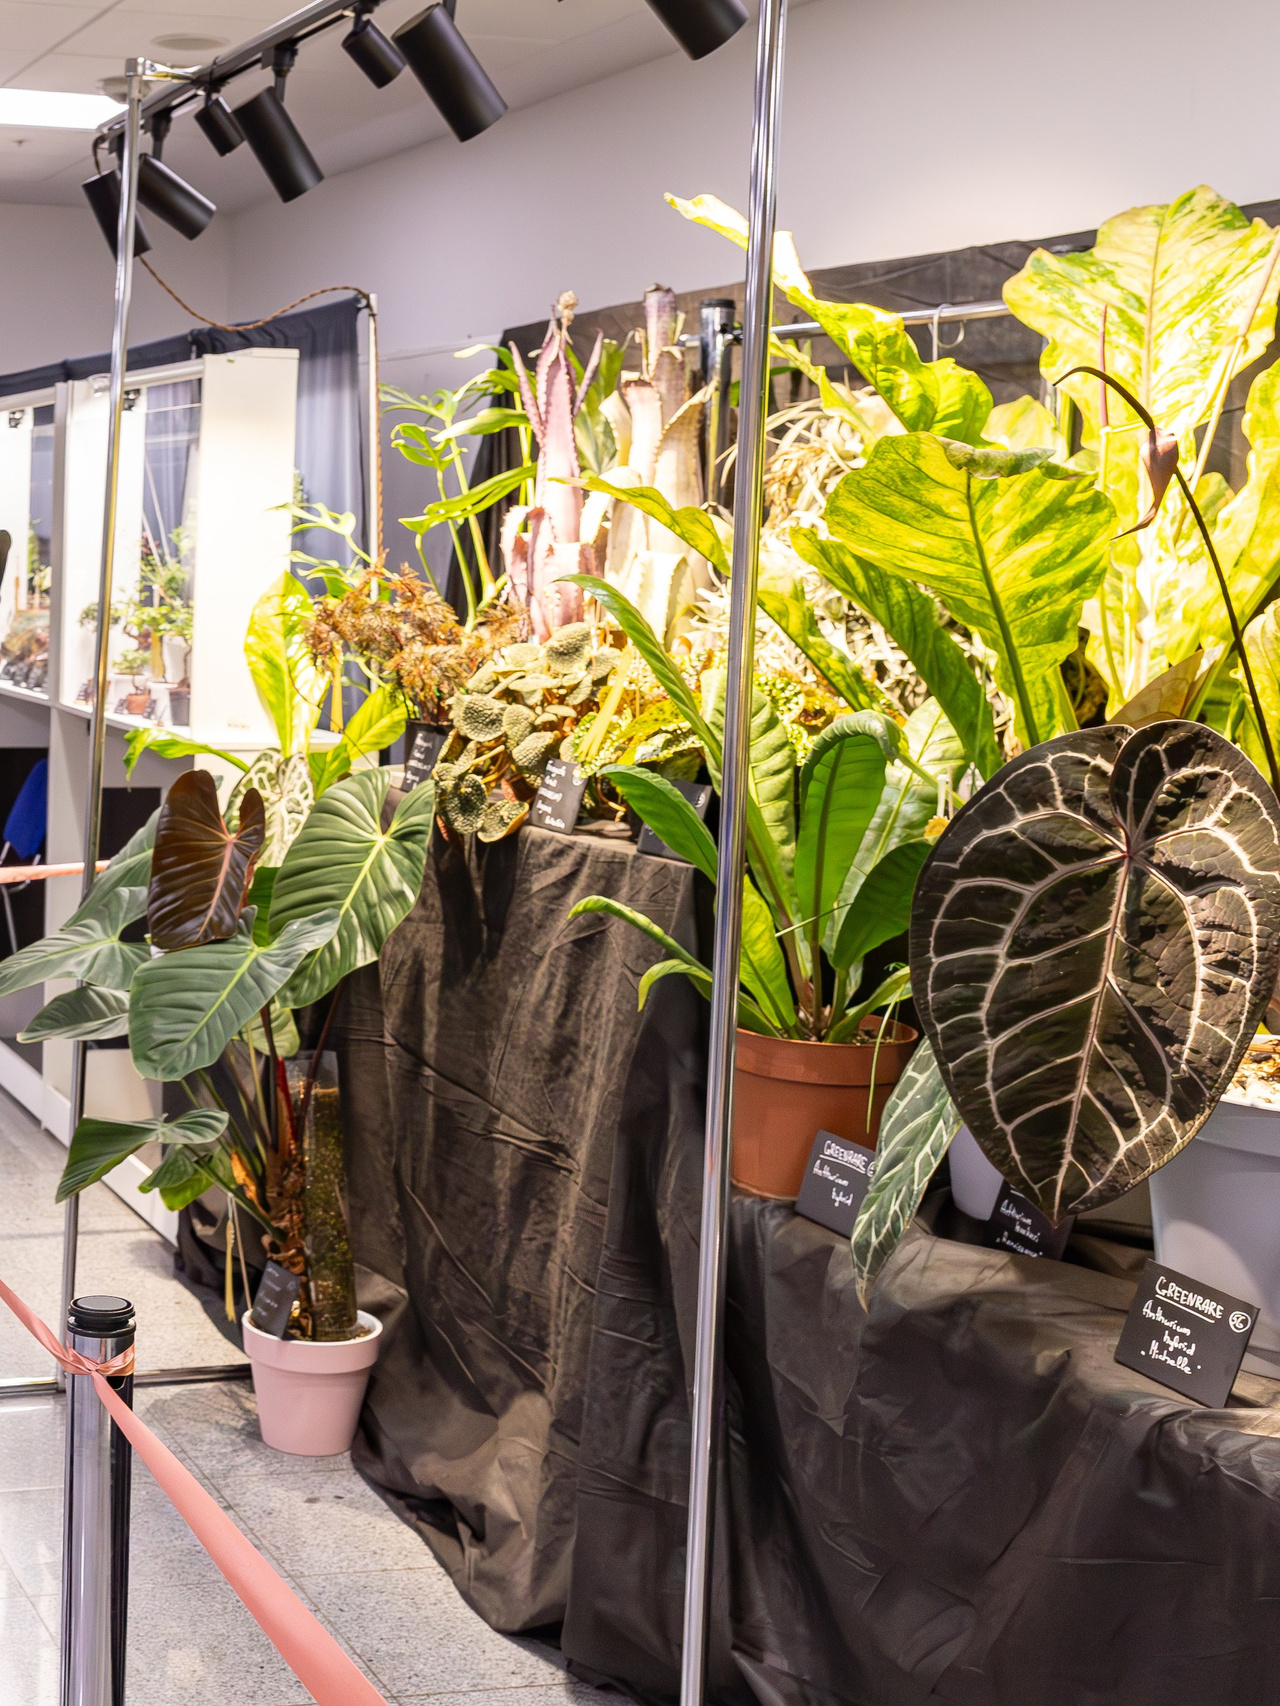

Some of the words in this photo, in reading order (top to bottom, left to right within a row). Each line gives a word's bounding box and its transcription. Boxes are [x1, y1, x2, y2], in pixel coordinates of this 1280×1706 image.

[1155, 1276, 1225, 1319] GREENRARE
[1142, 1300, 1191, 1336] Anthurium
[1163, 1330, 1197, 1357] hybrid
